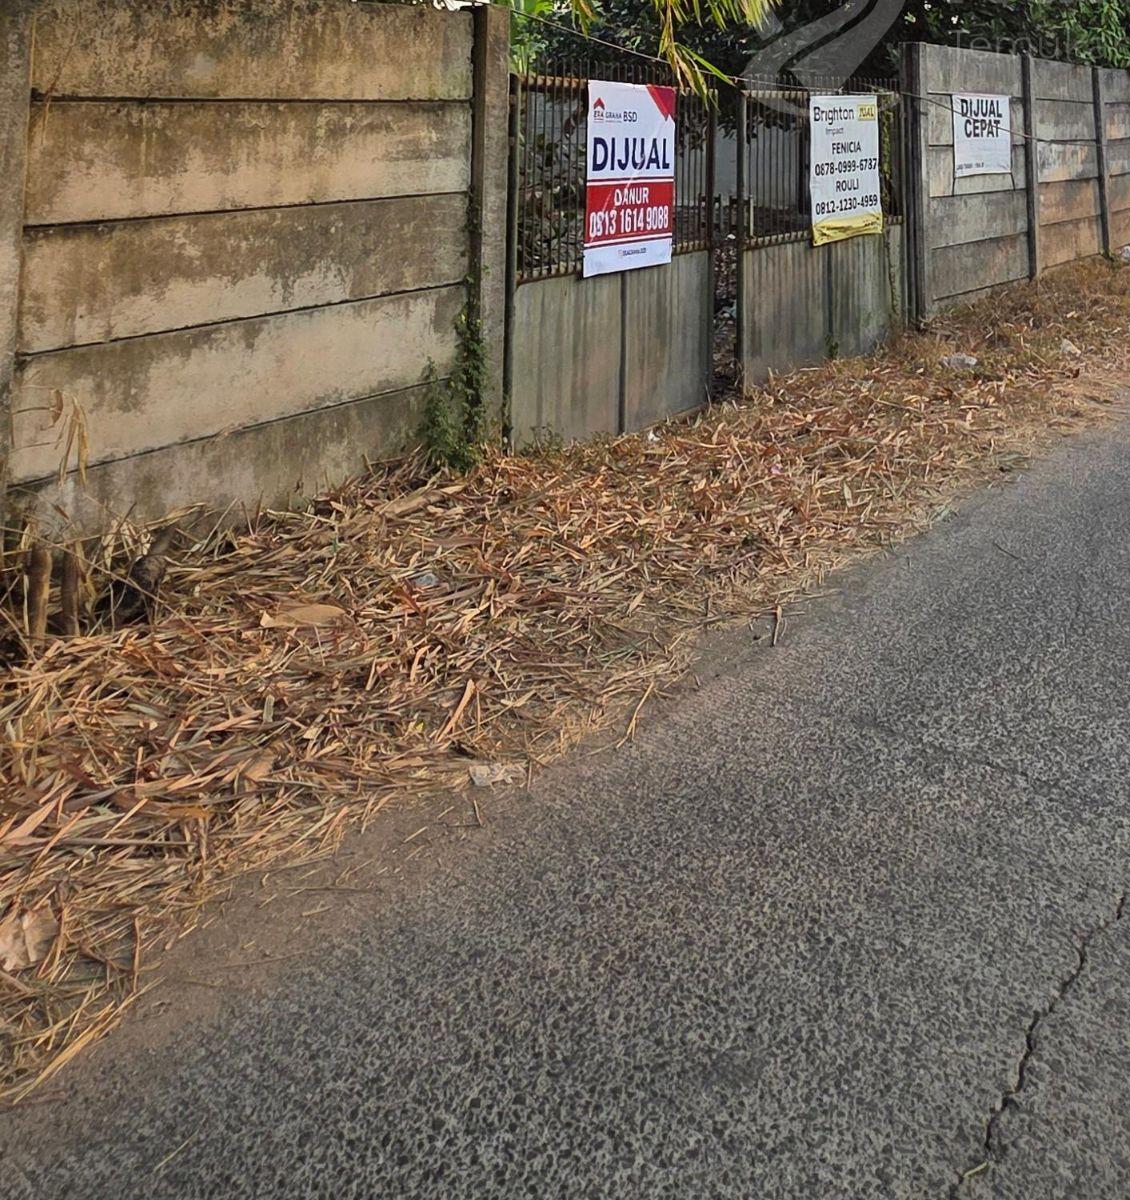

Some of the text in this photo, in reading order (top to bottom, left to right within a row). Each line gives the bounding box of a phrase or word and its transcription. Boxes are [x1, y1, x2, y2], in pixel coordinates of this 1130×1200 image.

[623, 110, 638, 123] BSD
[813, 106, 855, 126] Brighton
[960, 98, 1003, 118] DIJUAL
[964, 118, 1001, 138] CEPAT
[592, 137, 670, 171] DIJUAL
[832, 140, 862, 155] FENICIA
[835, 178, 860, 193] ROULI
[614, 187, 649, 206] DANUR
[815, 194, 879, 216] 0812-1230-4959
[589, 205, 669, 238] 0813 1614 9088
